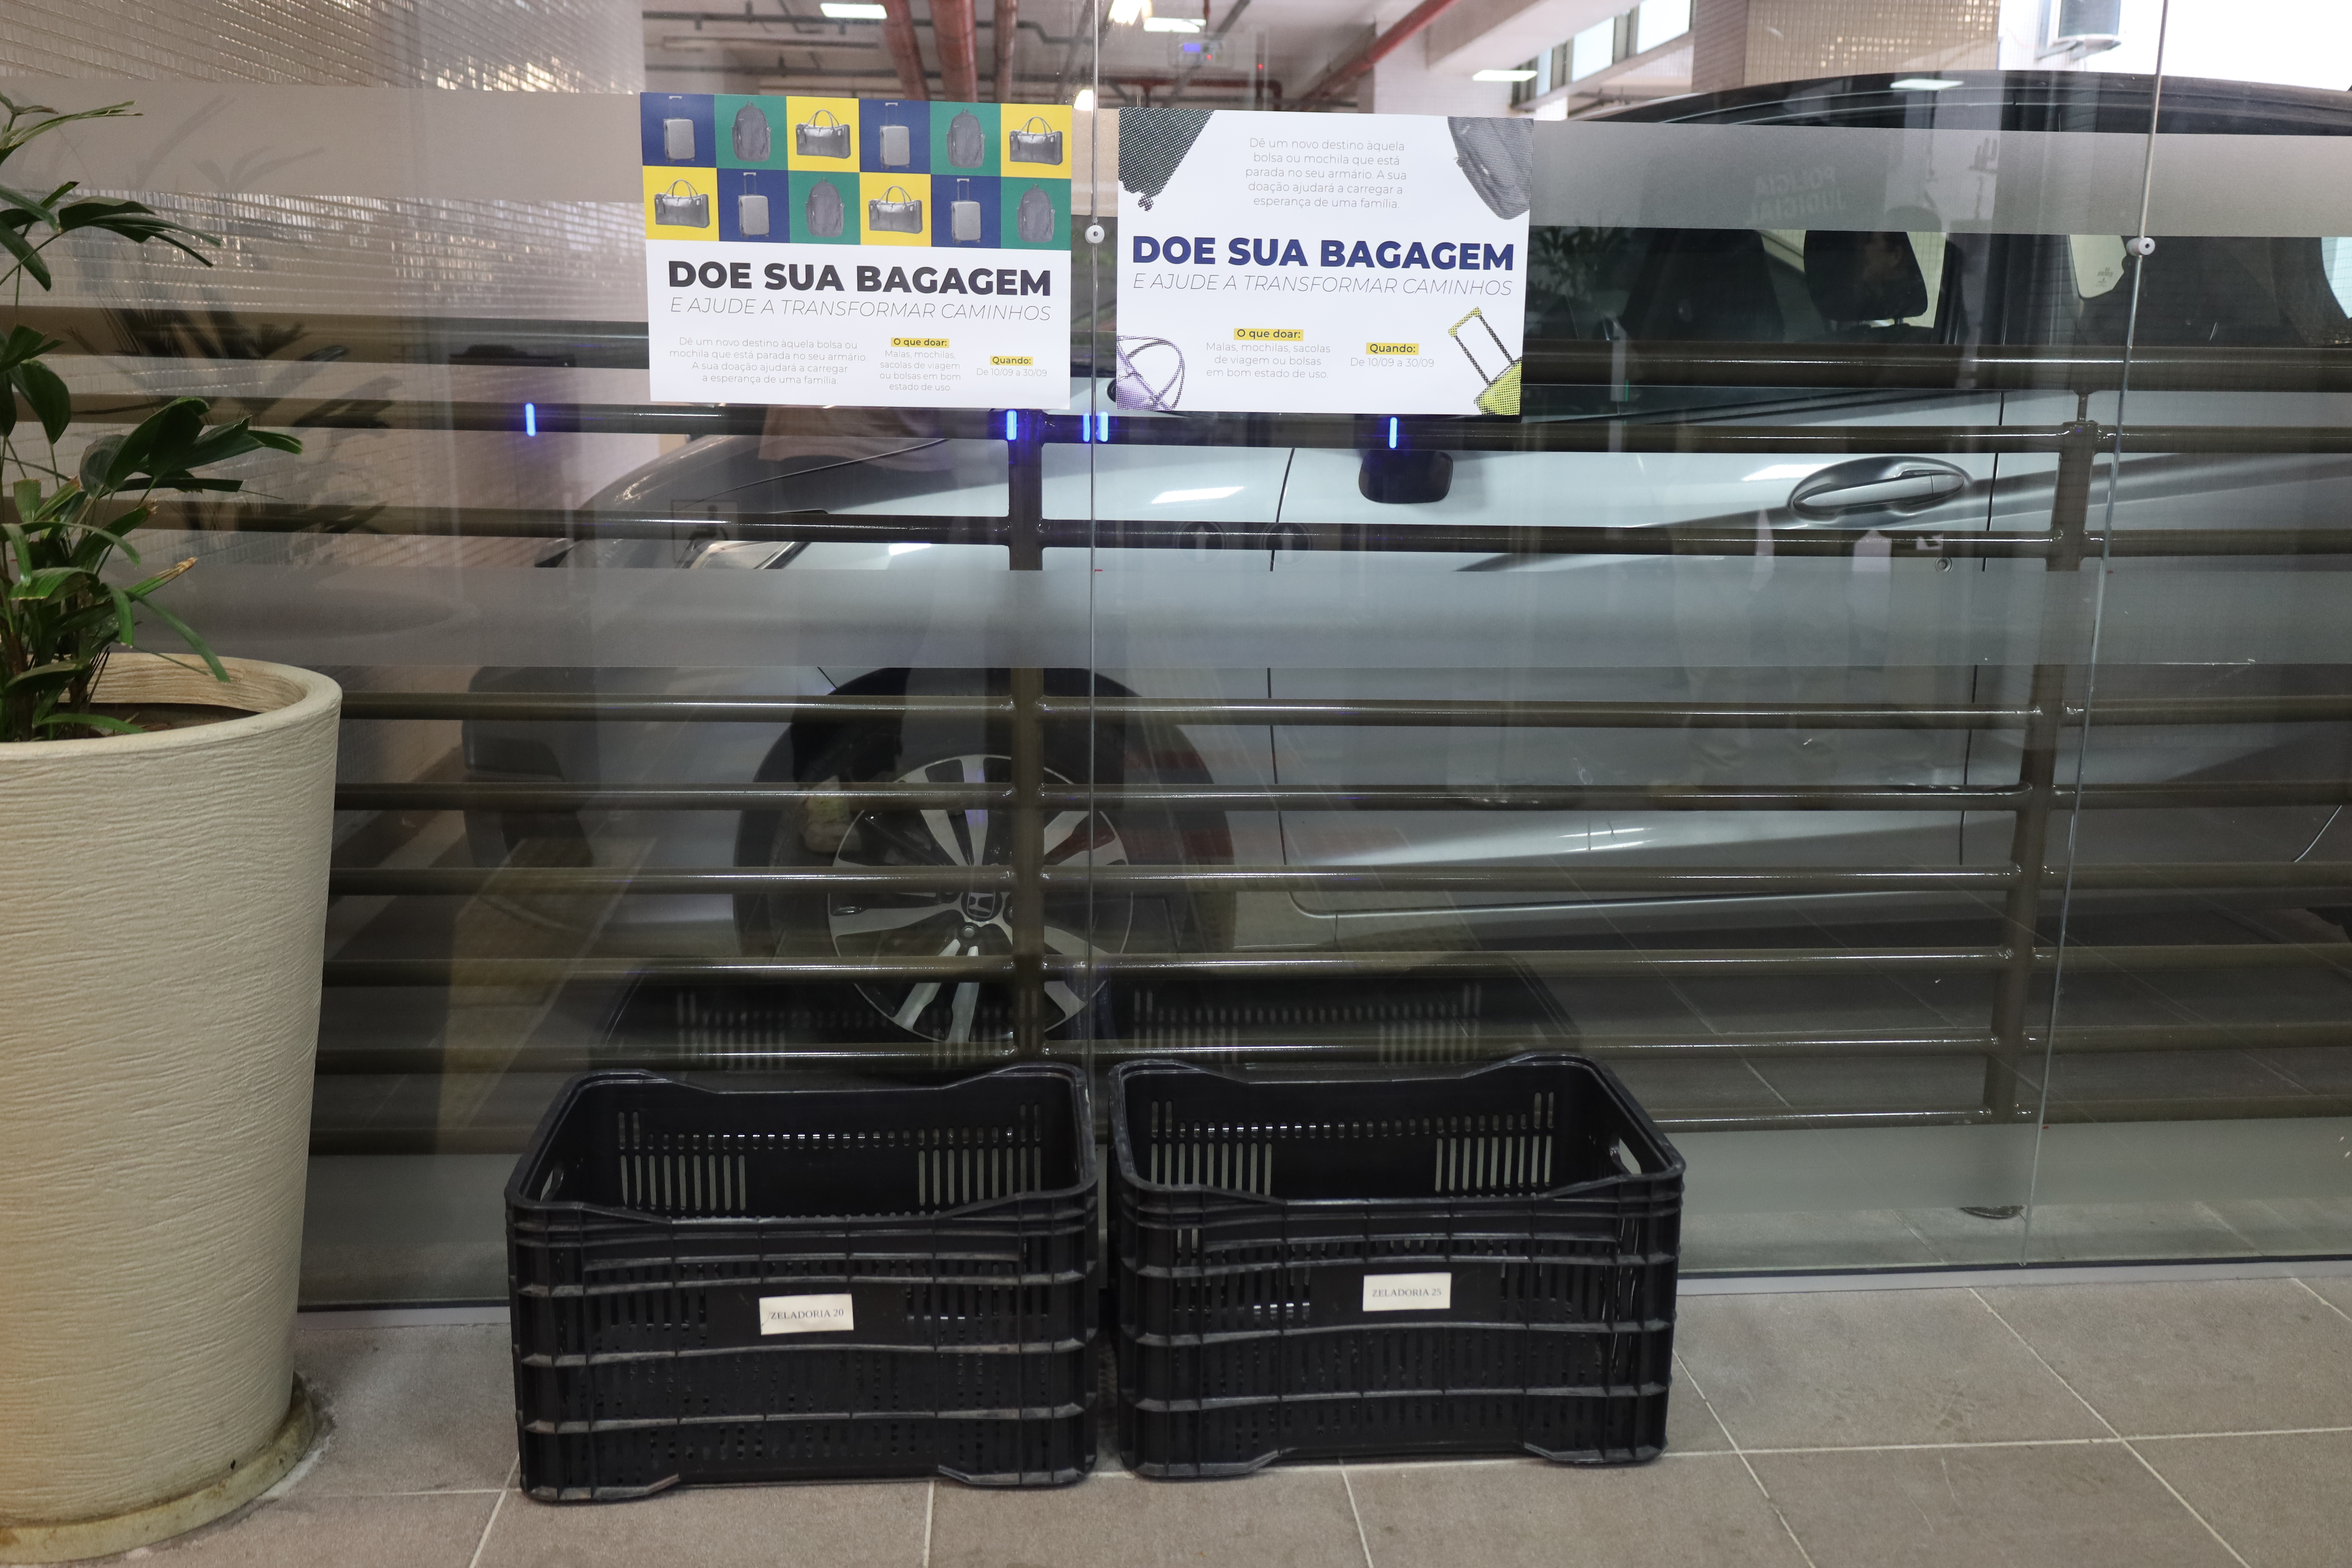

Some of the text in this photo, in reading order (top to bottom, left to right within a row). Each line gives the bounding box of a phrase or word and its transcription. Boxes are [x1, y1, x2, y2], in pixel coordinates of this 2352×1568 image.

[1250, 138, 1265, 148] Dê
[1322, 139, 1363, 150] destino
[1367, 141, 1404, 153] àquela
[1254, 152, 1282, 162] bolsa
[1305, 154, 1348, 164] mochila
[1352, 157, 1374, 167] que
[1377, 156, 1399, 165] está
[1246, 167, 1284, 178] parada
[1328, 169, 1373, 179] armário.
[1377, 170, 1384, 179] A
[1248, 181, 1289, 193] doação
[1293, 182, 1334, 194] ajudará
[1347, 185, 1393, 196] carregar
[1254, 198, 1310, 209] esperança
[1314, 197, 1328, 207] de
[1361, 198, 1399, 208] família.
[1133, 236, 1514, 271] DOE SUA BAGAGEM
[669, 260, 1050, 296] DOE SUA BAGAGEM
[1134, 273, 1513, 296] E AJUDE A TRANSFORMAR CAMINHOS
[671, 297, 1051, 321] E AJUDE A TRANSFORMAR CAMINHOS
[1237, 329, 1300, 340] O que doar:
[680, 337, 693, 345] Dê
[742, 338, 778, 347] destino
[781, 339, 813, 349] àquela
[818, 340, 842, 349] bolsa
[1207, 342, 1330, 353] Malas, mochilas, sacolas
[1370, 344, 1415, 354] Quando:
[670, 349, 709, 358] mochila
[734, 351, 753, 359] está
[757, 351, 790, 361] parada
[828, 352, 867, 361] armário.
[885, 350, 956, 360] Malas, mochilas,
[992, 356, 1031, 365] Quando:
[1214, 355, 1227, 364] de
[1230, 355, 1269, 366] viagem
[1290, 356, 1321, 365] bolsas
[928, 362, 960, 371] viagem
[1351, 357, 1364, 366] De
[1368, 357, 1394, 368] 10/09
[1406, 357, 1434, 368] 30/09
[721, 362, 758, 372] doação
[760, 363, 796, 373] ajudará
[807, 366, 848, 375] carregar
[991, 367, 1013, 377] 10/09
[1023, 368, 1047, 377] 30/09
[1228, 368, 1251, 377] bom
[1255, 369, 1289, 377] estado
[1292, 369, 1305, 378] de
[710, 375, 760, 385] esperança
[764, 375, 776, 383] de
[804, 375, 838, 384] família.
[1372, 1288, 1442, 1297] ZELADORIA 25
[769, 1309, 830, 1320] ZELADORIA
